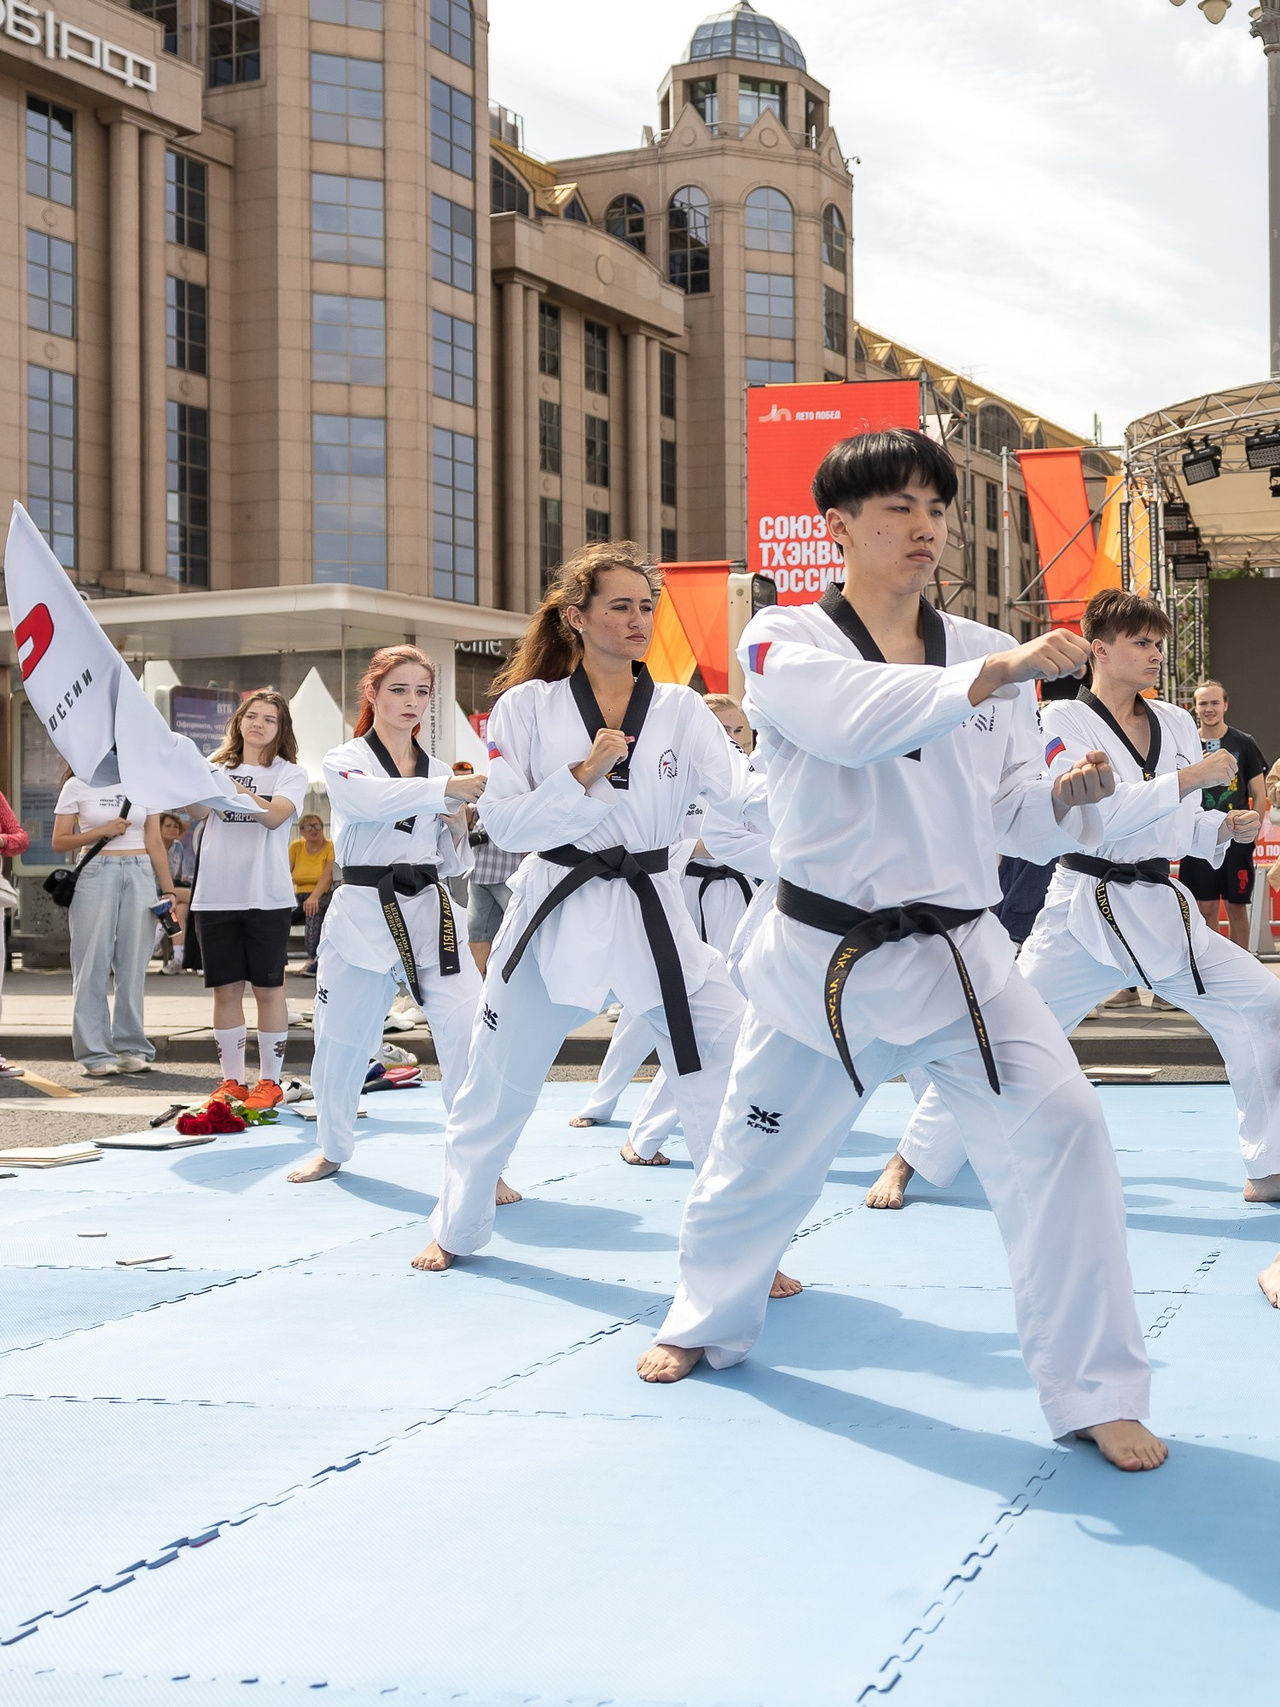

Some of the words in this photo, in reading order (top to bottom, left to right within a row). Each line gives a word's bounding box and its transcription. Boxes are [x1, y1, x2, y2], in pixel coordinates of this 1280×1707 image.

[795, 411, 814, 421] ЛЕТО
[815, 410, 841, 420] ПОБЕД
[759, 515, 827, 540] СОЮЗ
[758, 540, 845, 567] ТХЭКВО
[48, 668, 93, 732] ОССИИ
[216, 703, 233, 714] ВТБ
